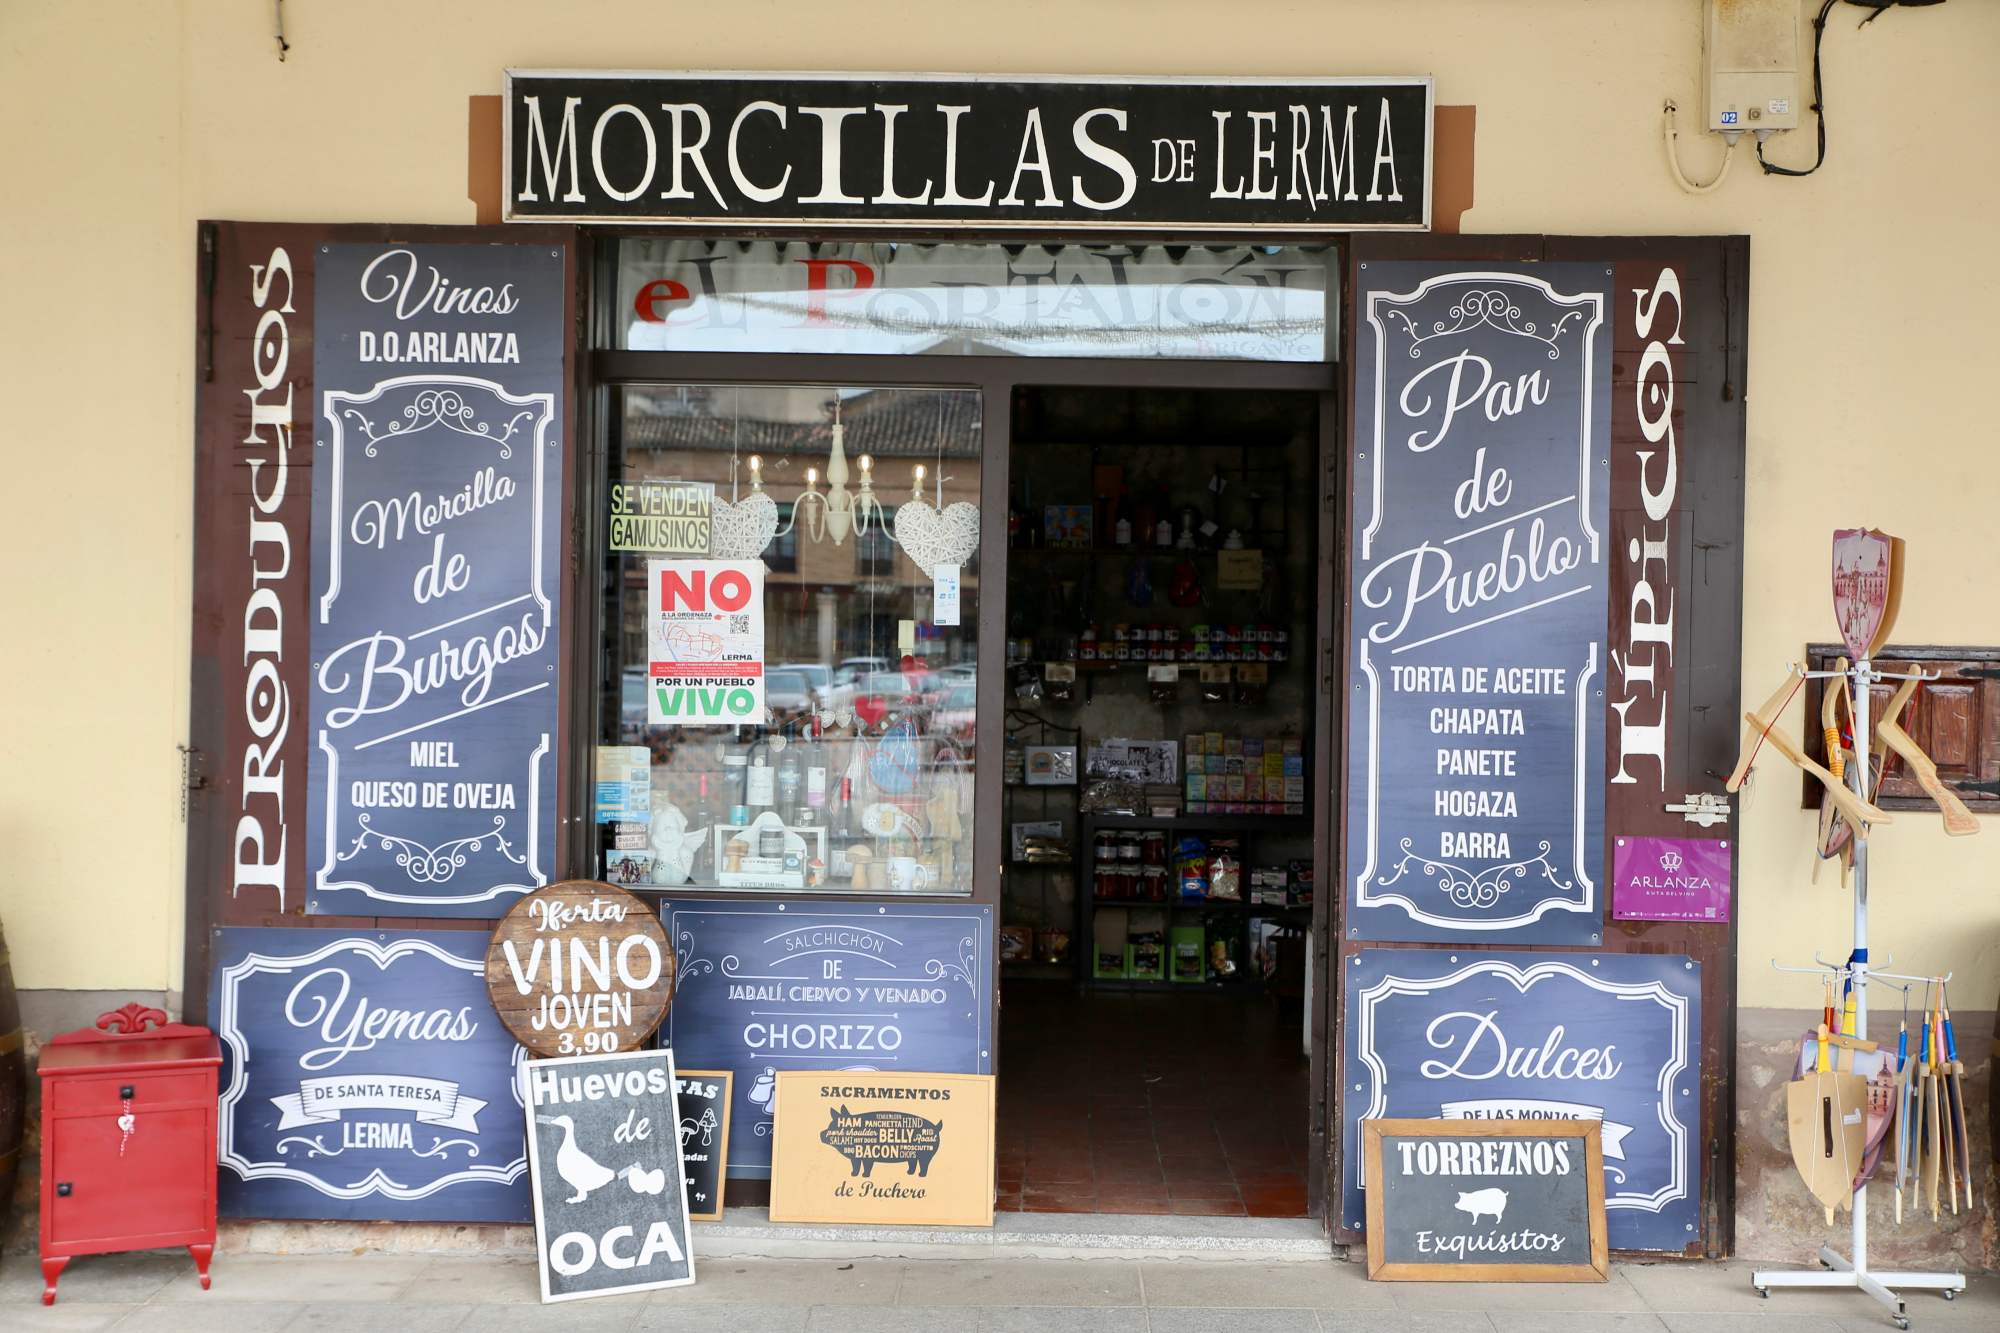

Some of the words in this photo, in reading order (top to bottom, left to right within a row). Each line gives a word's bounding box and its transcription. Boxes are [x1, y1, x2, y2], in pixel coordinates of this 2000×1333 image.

[1721, 112, 1737, 123] 02
[517, 93, 1138, 211] MORCILLAS
[1151, 137, 1196, 183] DE
[1209, 96, 1404, 212] LERMA
[361, 249, 519, 320] Vinos
[359, 331, 520, 364] D.O.ARLANZA
[1399, 349, 1550, 453] Pan
[1453, 447, 1513, 519] de
[351, 466, 515, 549] Morcilla
[611, 484, 634, 514] SE
[639, 485, 709, 517] VENDEN
[611, 517, 709, 550] GAMUSINOS
[233, 246, 296, 914] PRODUCTOS
[413, 532, 470, 604] de
[1360, 517, 1582, 644] Pueblo
[661, 569, 752, 612] NO
[318, 612, 547, 729] Burgos
[656, 678, 681, 686] POR
[685, 678, 702, 686] UN
[706, 678, 755, 686] PUEBLO
[1390, 664, 1456, 694] TORTA
[1461, 666, 1486, 693] DE
[1493, 666, 1566, 695] ACEITE
[656, 688, 755, 716] VIVO
[1429, 707, 1525, 736] CHAPATA
[410, 741, 459, 768] MIEL
[1437, 748, 1517, 777] PANETE
[351, 780, 417, 808] QUESO
[422, 782, 448, 808] DE
[453, 782, 516, 810] OVEJA
[1434, 790, 1518, 818] HOGAZA
[1440, 831, 1511, 860] BARRA
[1630, 875, 1711, 889] ARLANZA
[529, 897, 628, 931] Oferta
[785, 932, 885, 953] SALCHICHÓN
[502, 934, 662, 995] VINO
[822, 959, 843, 979] DE
[789, 986, 851, 1003] CIERVO
[854, 987, 870, 1002] Y
[874, 987, 947, 1004] VENADO
[285, 967, 478, 1071] Yemas
[531, 991, 632, 1031] JOVEN
[558, 1031, 618, 1056] 3,90
[743, 1023, 902, 1050] CHORIZO
[1420, 1010, 1622, 1080] Dulces
[315, 1087, 333, 1100] DE
[338, 1085, 384, 1097] SANTA
[388, 1086, 442, 1102] TERESA
[532, 1067, 668, 1106] Huevos
[820, 1086, 951, 1100] SACRAMENTOS
[614, 1108, 651, 1144] de
[837, 1117, 861, 1127] HAM
[902, 1117, 923, 1128] HIND
[1463, 1110, 1481, 1120] DE
[1487, 1109, 1514, 1120] LAS
[343, 1122, 413, 1148] LERMA
[830, 1136, 854, 1145] SALAMI
[879, 1128, 914, 1143] BELLY
[855, 1145, 899, 1158] BACON
[1397, 1141, 1570, 1177] TORREZNOS
[835, 1181, 853, 1197] de
[858, 1180, 927, 1199] Puchero
[549, 1221, 684, 1277] OCA
